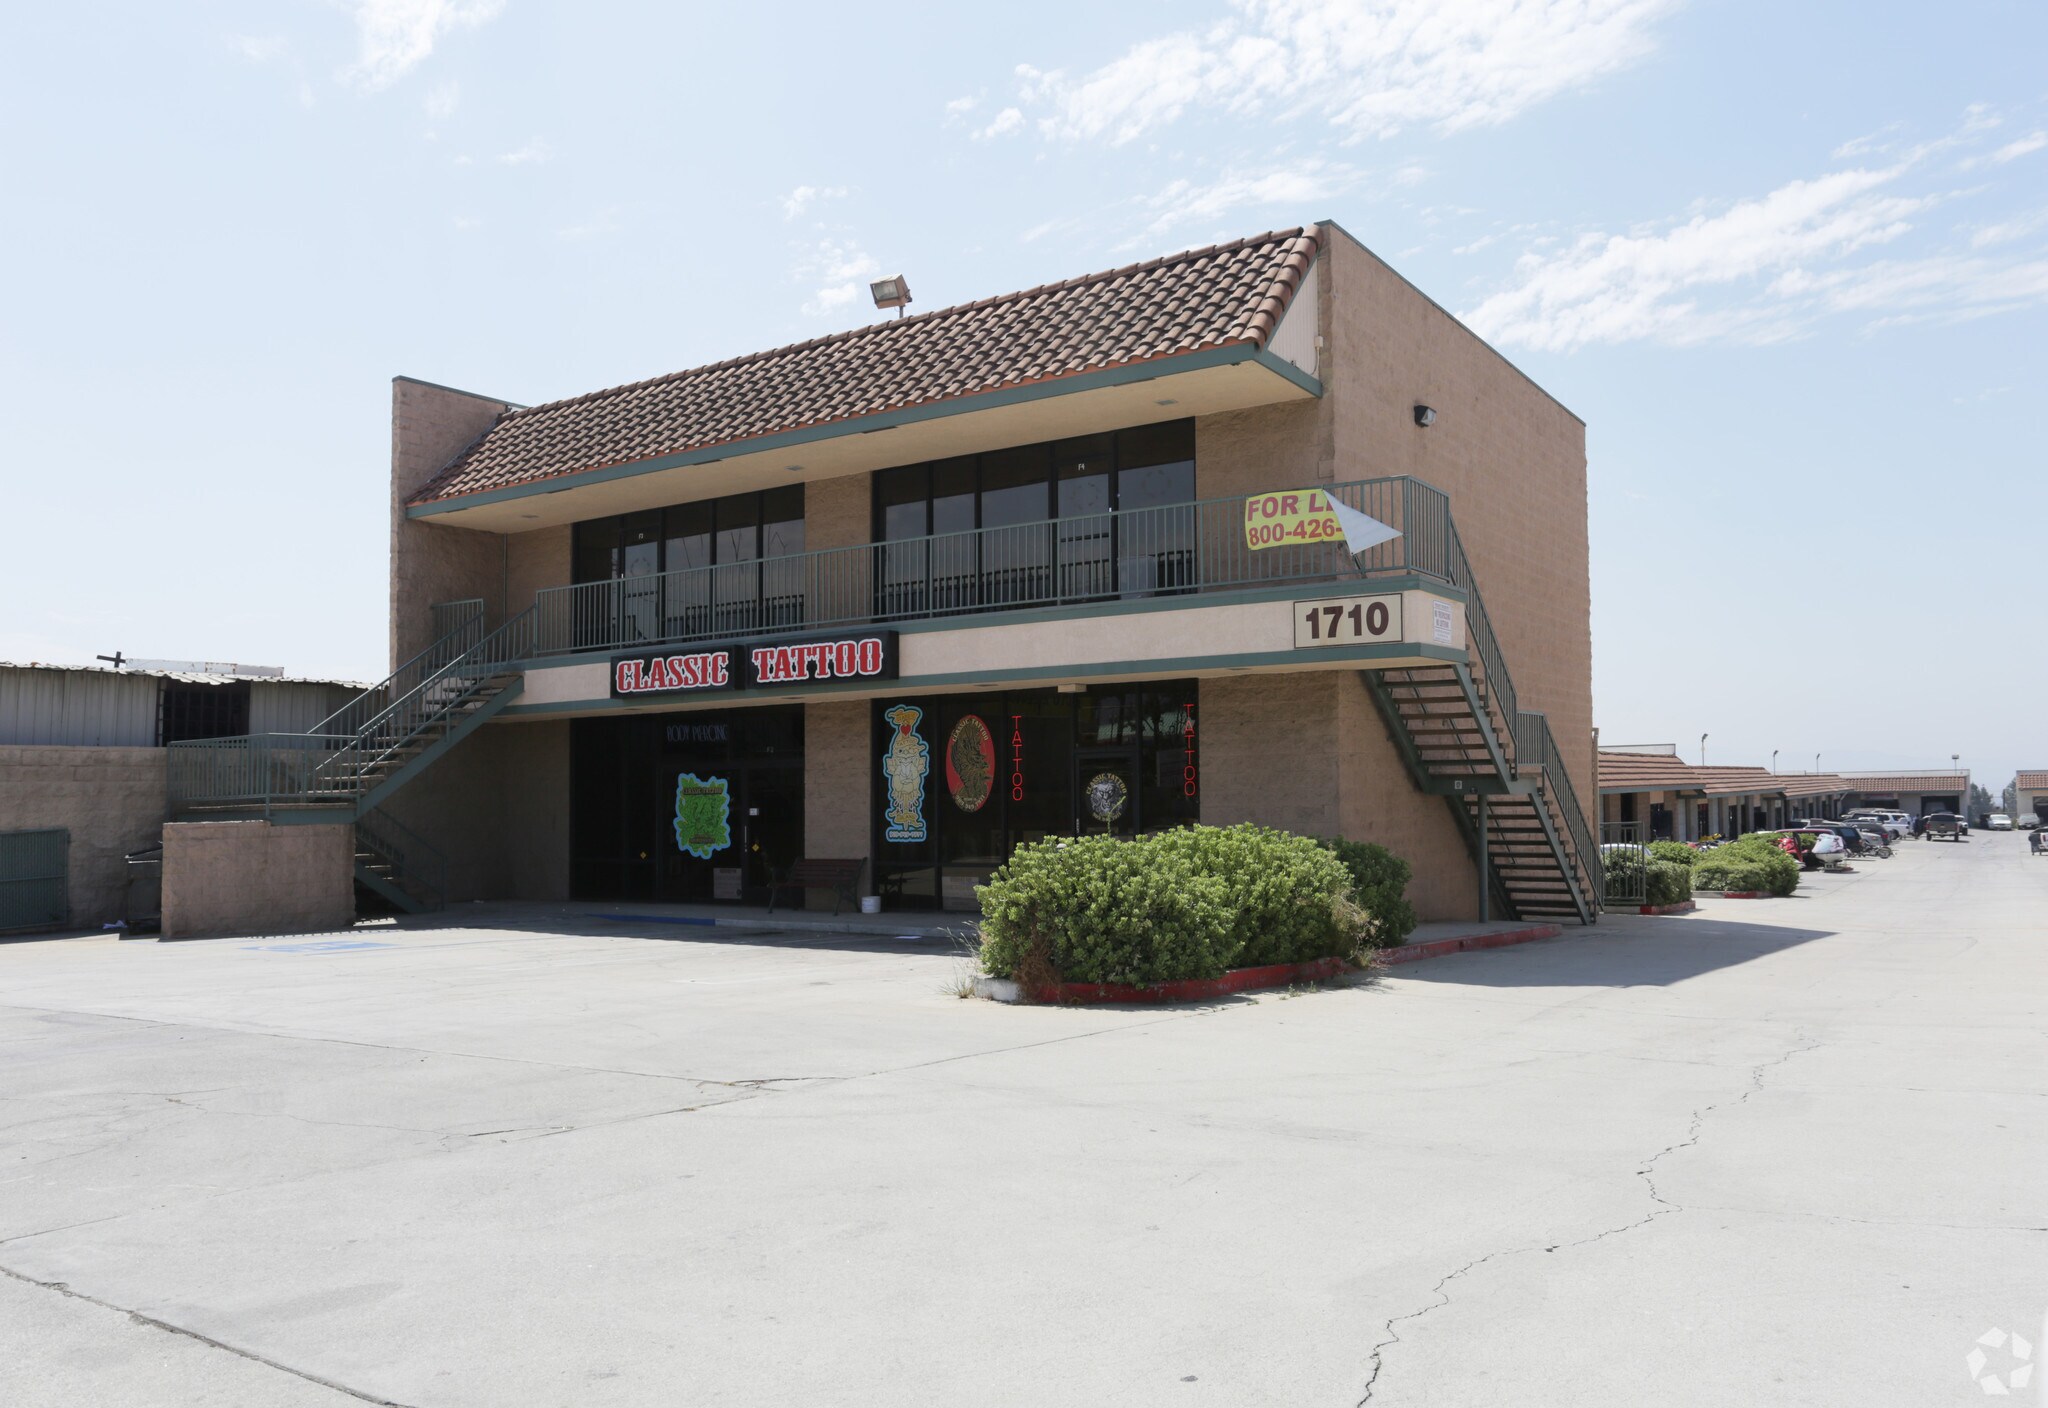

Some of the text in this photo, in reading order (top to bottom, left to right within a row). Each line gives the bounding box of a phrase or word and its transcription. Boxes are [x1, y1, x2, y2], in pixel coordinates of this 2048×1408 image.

[1248, 495, 1298, 521] FOR
[1306, 602, 1389, 639] 1710
[616, 638, 883, 693] CLASSIC TATTOO
[666, 724, 689, 741] BODY
[971, 718, 989, 741] TATTOO
[1012, 715, 1023, 801] TATTOO
[1183, 704, 1196, 796] TATTOO
[1086, 772, 1128, 795] CLASSIC TATTOO
